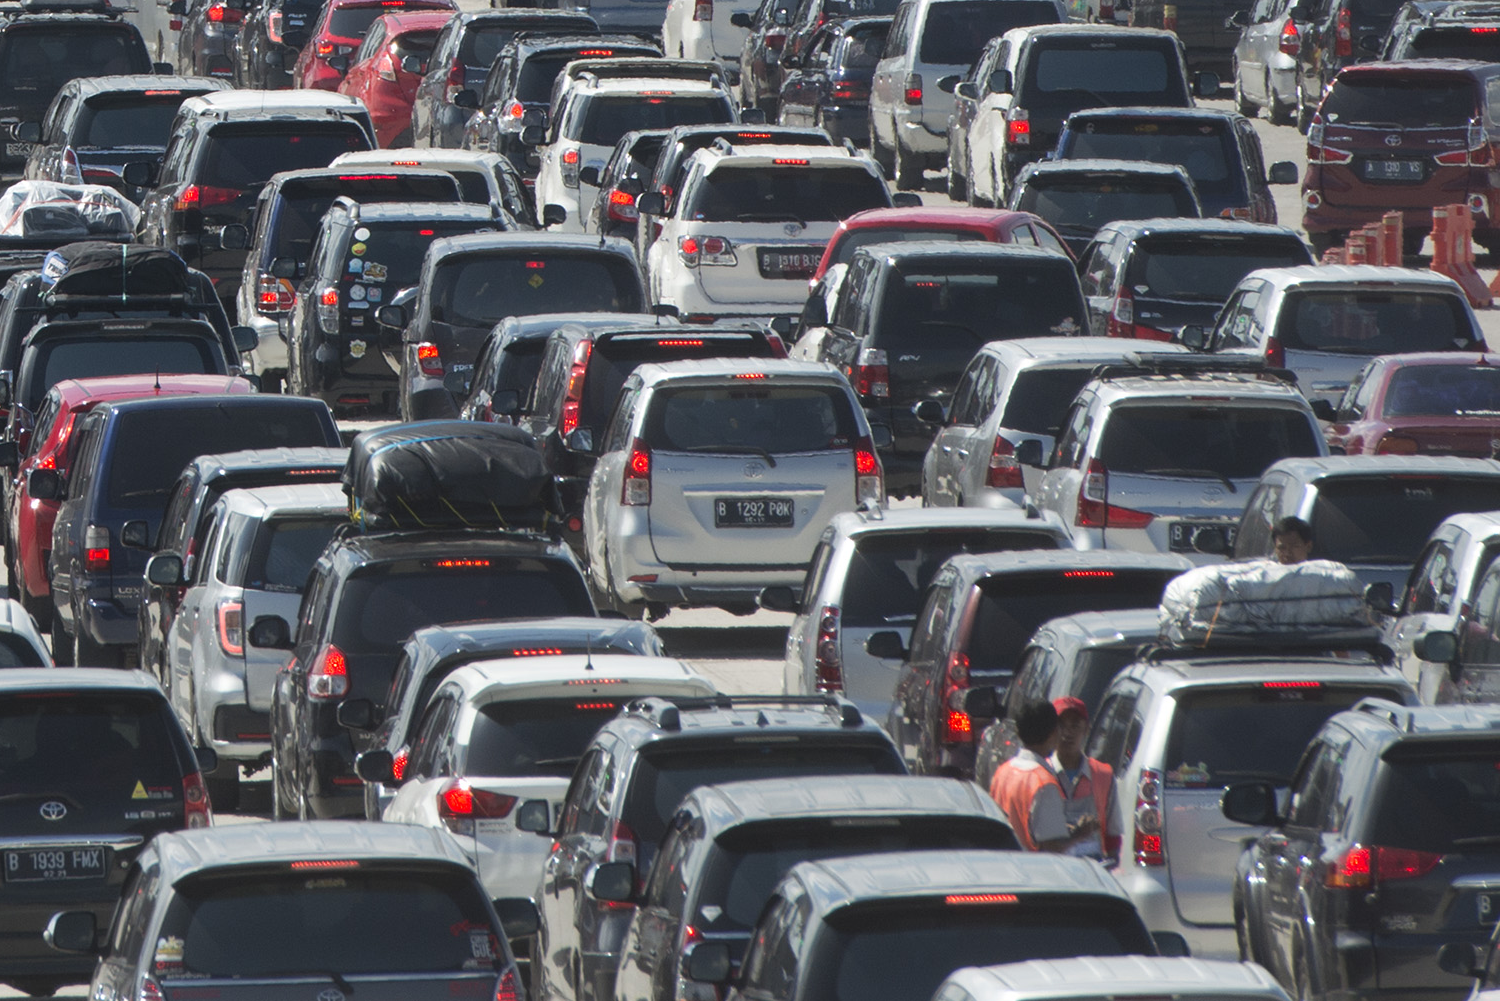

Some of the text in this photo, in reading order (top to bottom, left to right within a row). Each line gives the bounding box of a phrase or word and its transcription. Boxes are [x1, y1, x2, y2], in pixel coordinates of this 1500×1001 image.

[718, 503, 726, 517] B
[737, 503, 764, 517] 1292
[9, 851, 100, 871] B 1939 FMX
[1482, 895, 1491, 913] B
